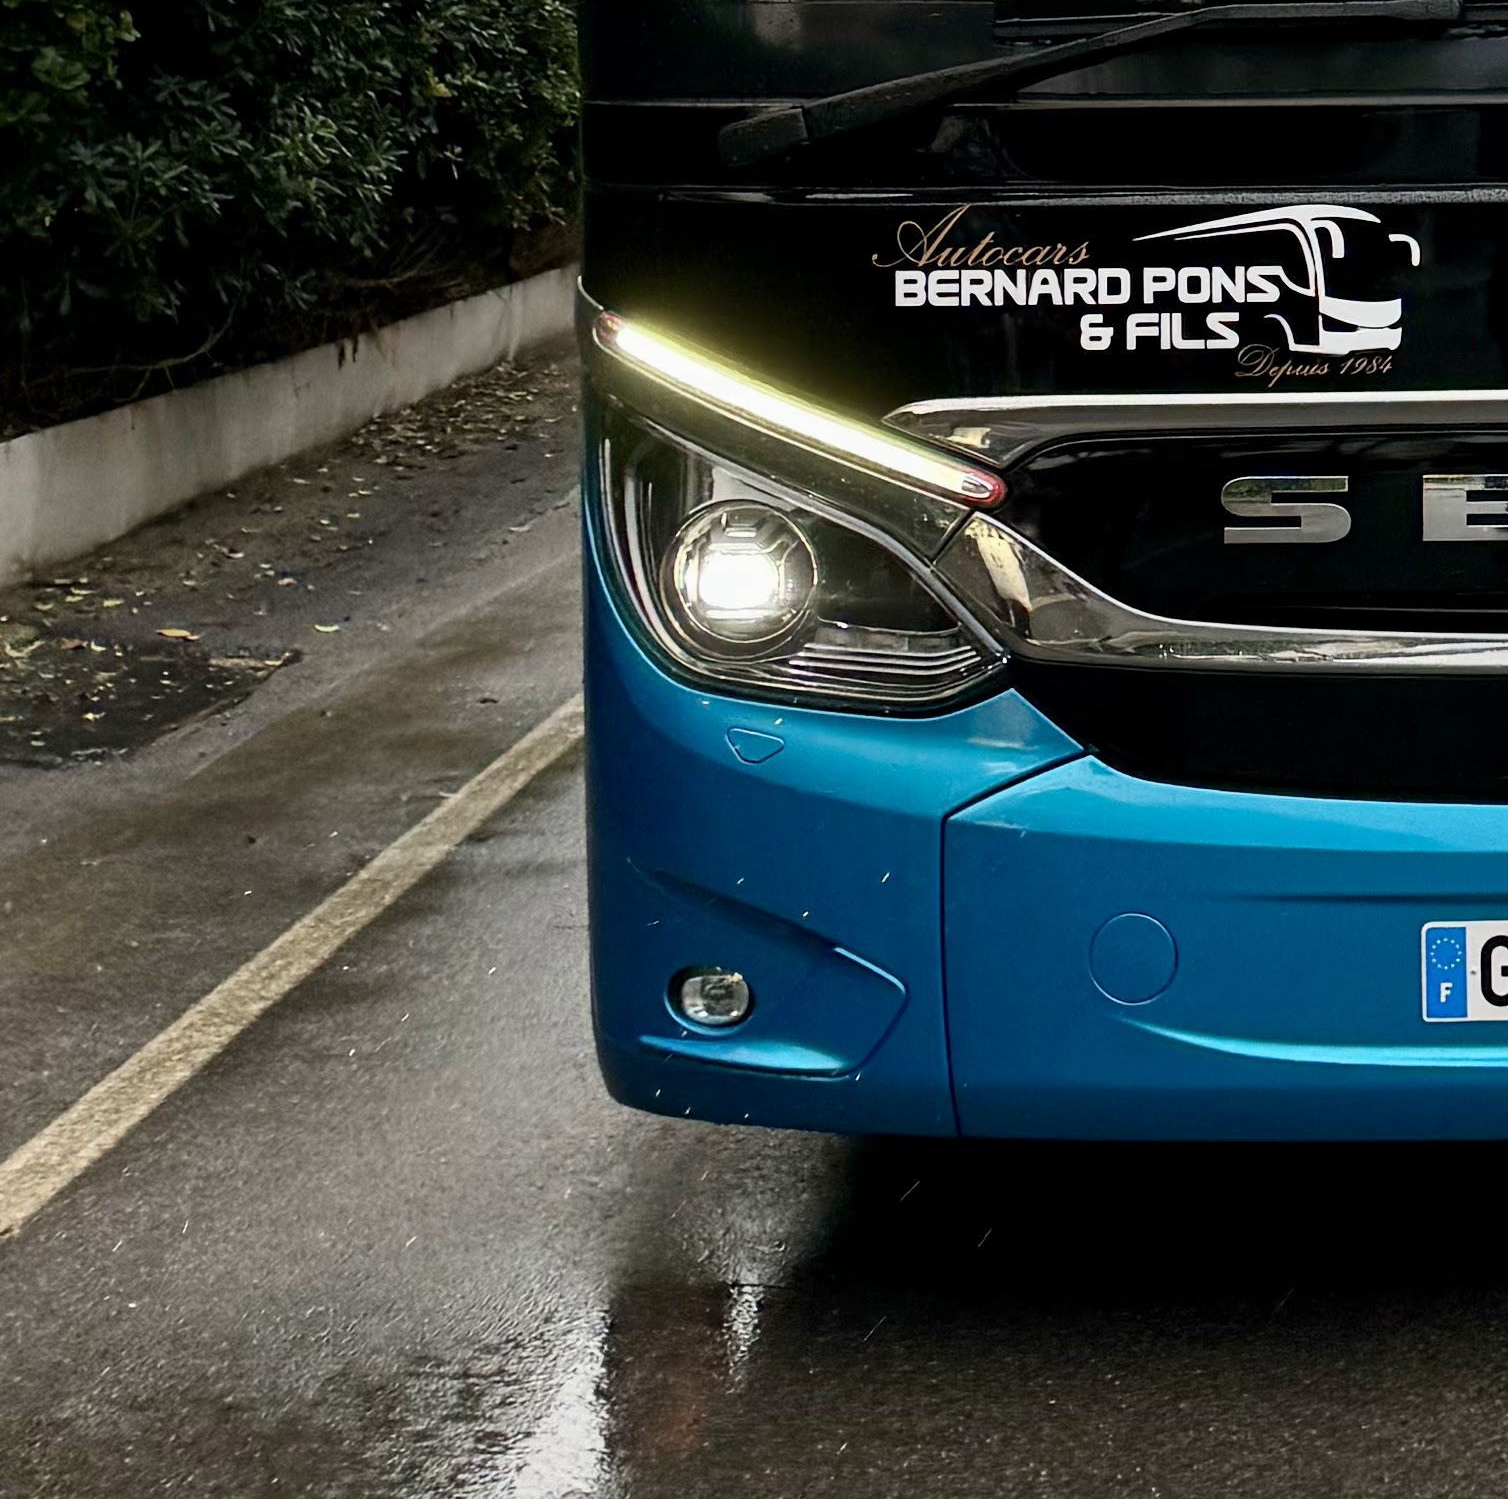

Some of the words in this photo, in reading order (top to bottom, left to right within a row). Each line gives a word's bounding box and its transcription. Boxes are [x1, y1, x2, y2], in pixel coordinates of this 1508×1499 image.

[871, 203, 1090, 267] Autocars
[895, 267, 1131, 307] BERNARD
[1143, 265, 1284, 304] PONS
[1079, 313, 1114, 351] &
[1126, 312, 1240, 350] FILS
[1233, 343, 1329, 388] Depuis
[1339, 355, 1394, 378] 1984
[1439, 981, 1454, 1003] F
